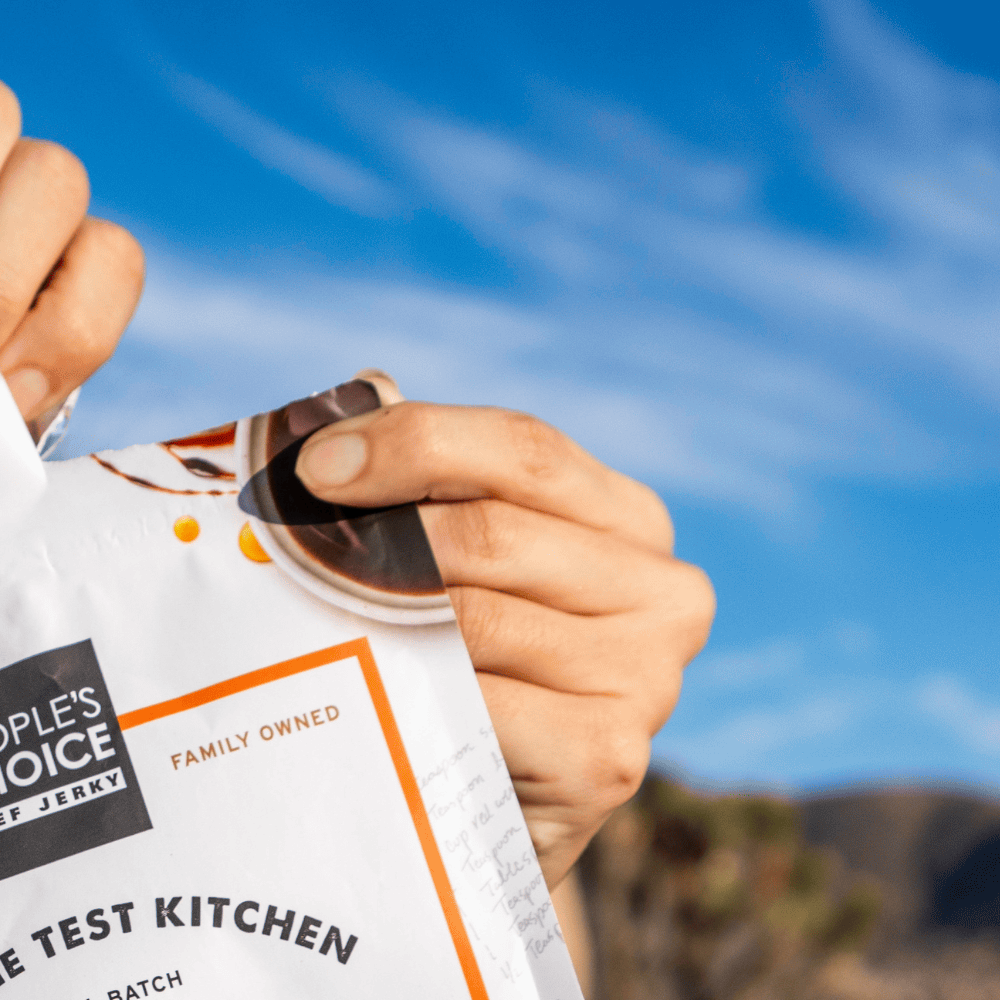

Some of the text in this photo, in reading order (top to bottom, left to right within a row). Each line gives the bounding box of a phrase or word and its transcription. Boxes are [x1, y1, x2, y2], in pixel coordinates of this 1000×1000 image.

[171, 705, 341, 771] FAMILY OWNED
[38, 772, 121, 812] JERKY
[31, 902, 134, 958] TEST
[155, 896, 359, 965] KITCHEN
